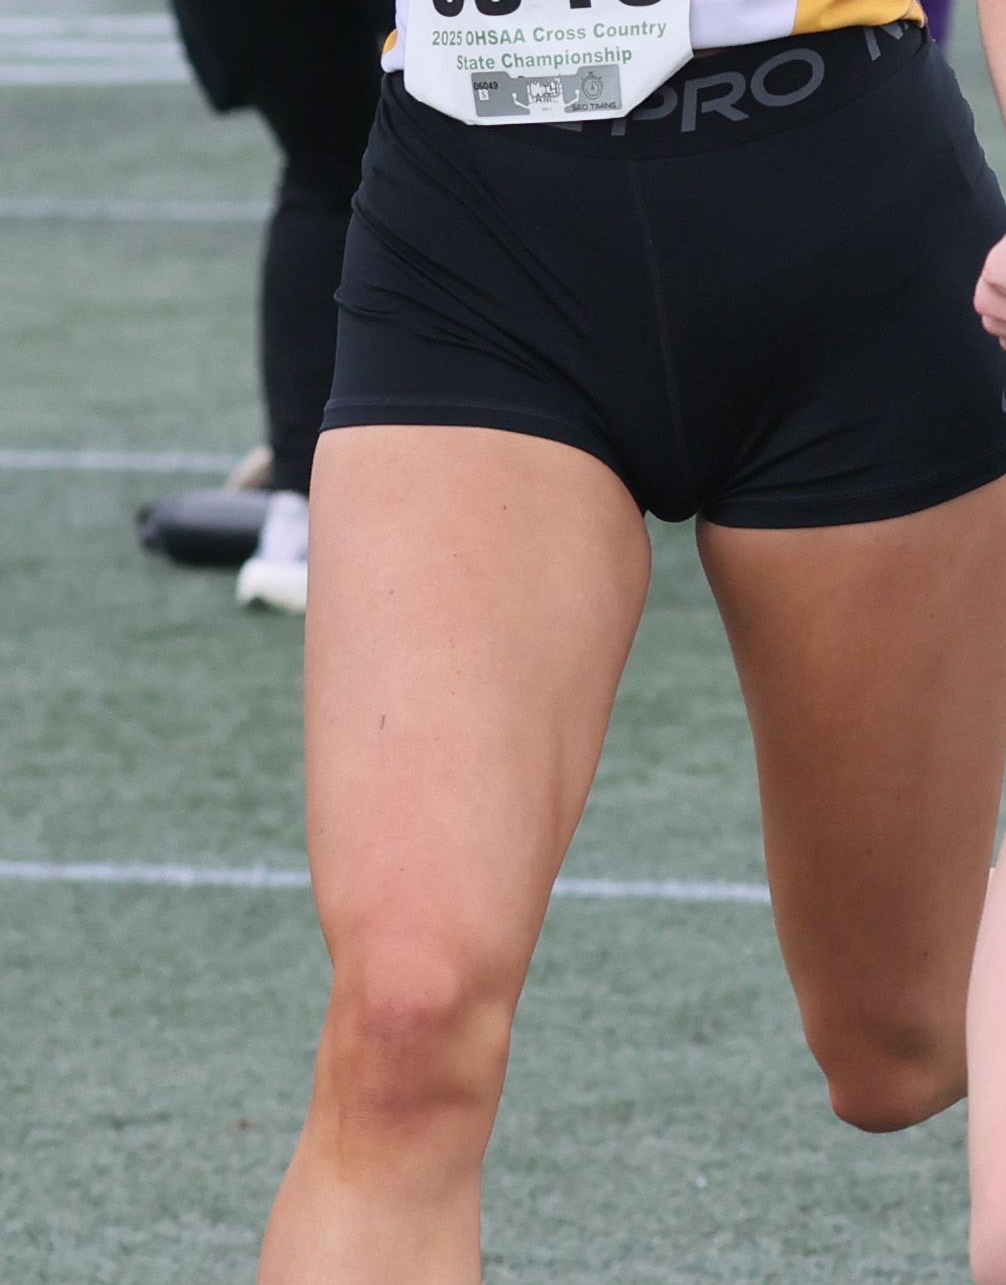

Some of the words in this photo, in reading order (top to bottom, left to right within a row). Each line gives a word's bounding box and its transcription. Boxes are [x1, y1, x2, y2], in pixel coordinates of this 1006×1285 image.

[432, 30, 462, 46] 2025
[466, 28, 526, 46] OHSAA
[533, 26, 586, 42] Cross
[593, 21, 667, 38] Country
[457, 54, 495, 70] State
[501, 46, 632, 69] Championship
